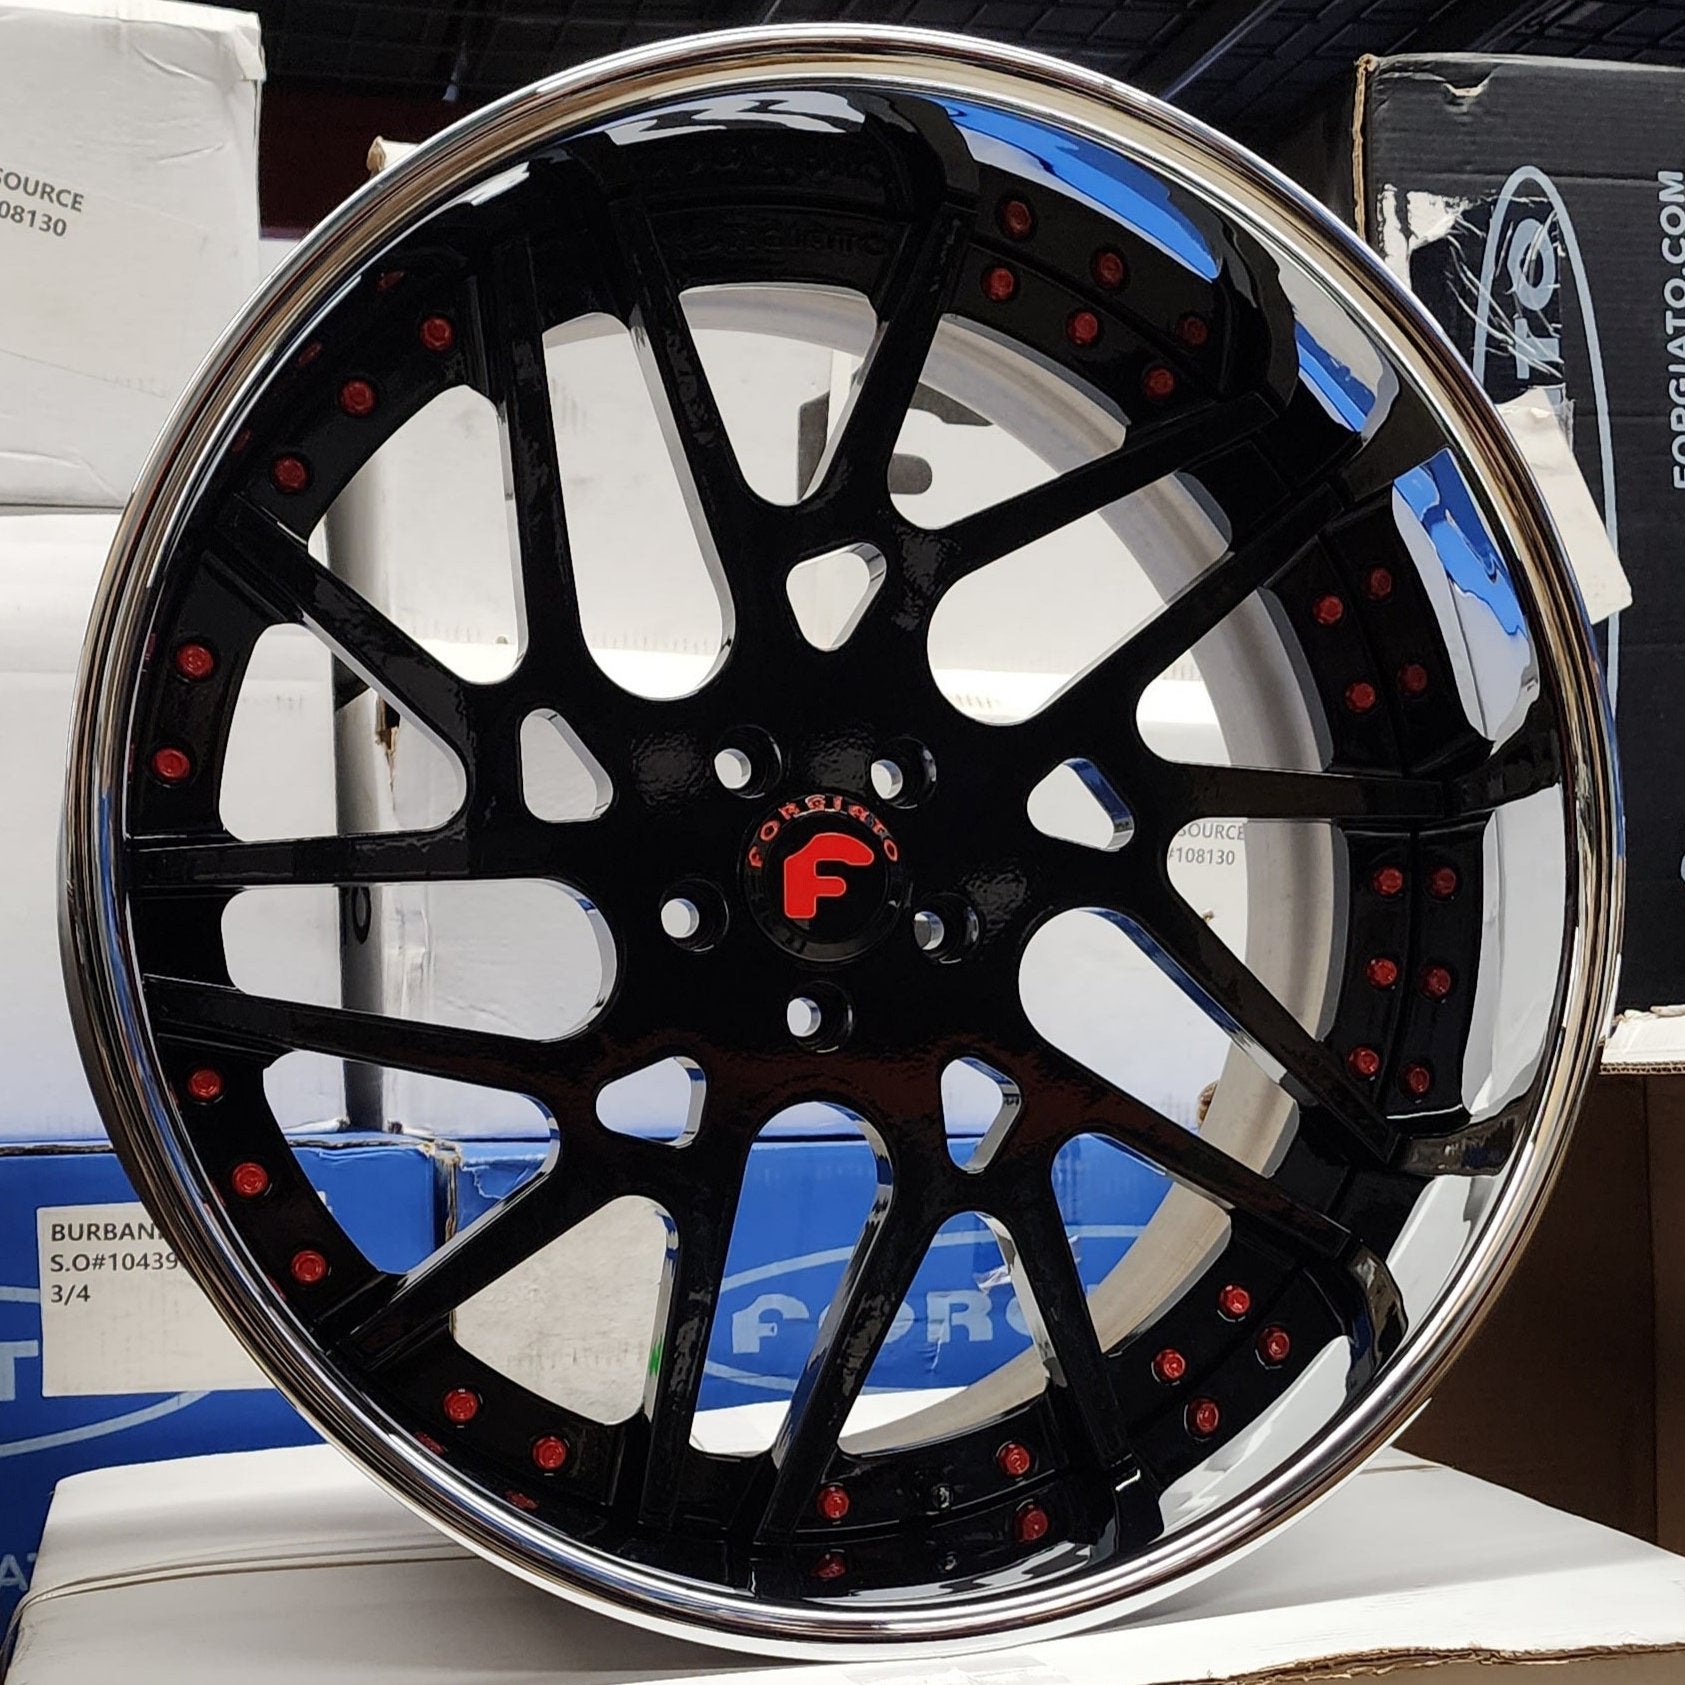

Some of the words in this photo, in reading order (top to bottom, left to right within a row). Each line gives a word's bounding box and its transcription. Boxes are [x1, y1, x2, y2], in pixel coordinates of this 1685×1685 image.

[0, 168, 84, 213] OURCE
[784, 832, 875, 919] F
[51, 1222, 162, 1242] BURBAN
[50, 1284, 91, 1306] 3/4
